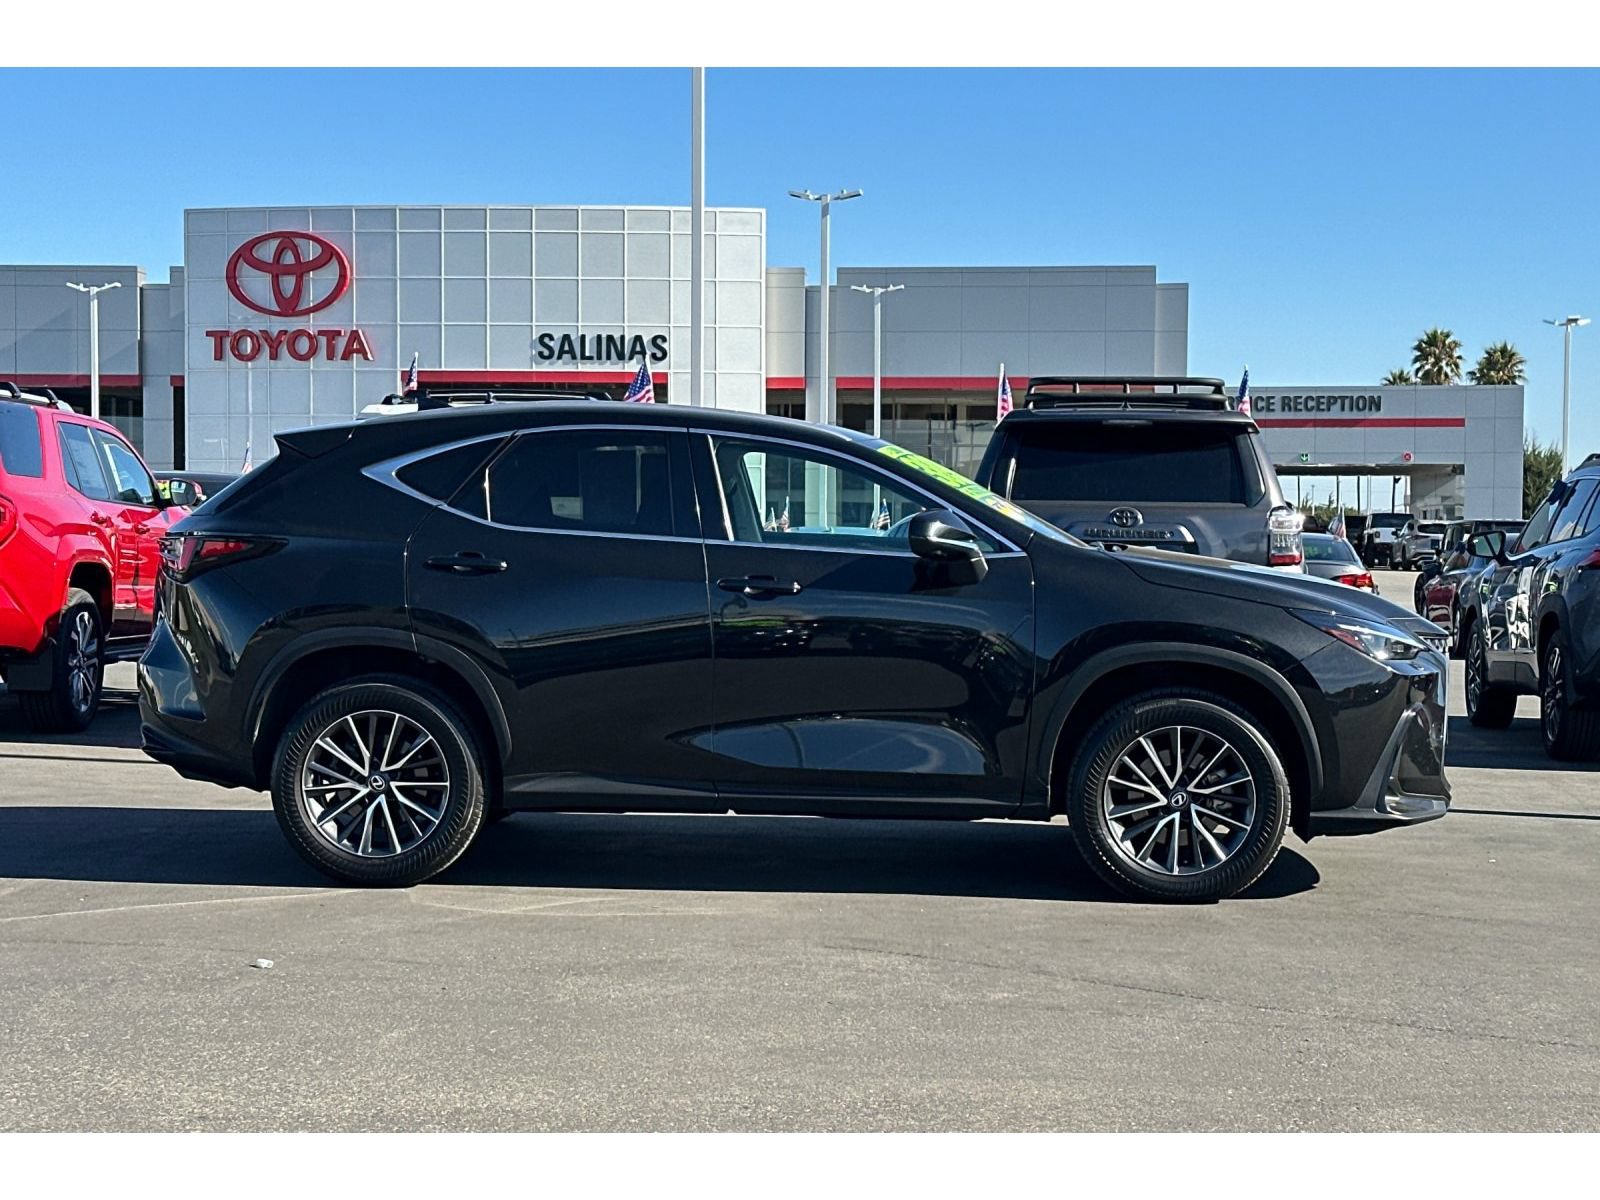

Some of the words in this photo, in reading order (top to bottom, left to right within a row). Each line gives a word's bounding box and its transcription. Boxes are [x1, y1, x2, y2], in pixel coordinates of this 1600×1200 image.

[205, 329, 374, 362] TOYOTA
[537, 333, 668, 362] SALINAS
[1281, 395, 1382, 412] RECEPTION
